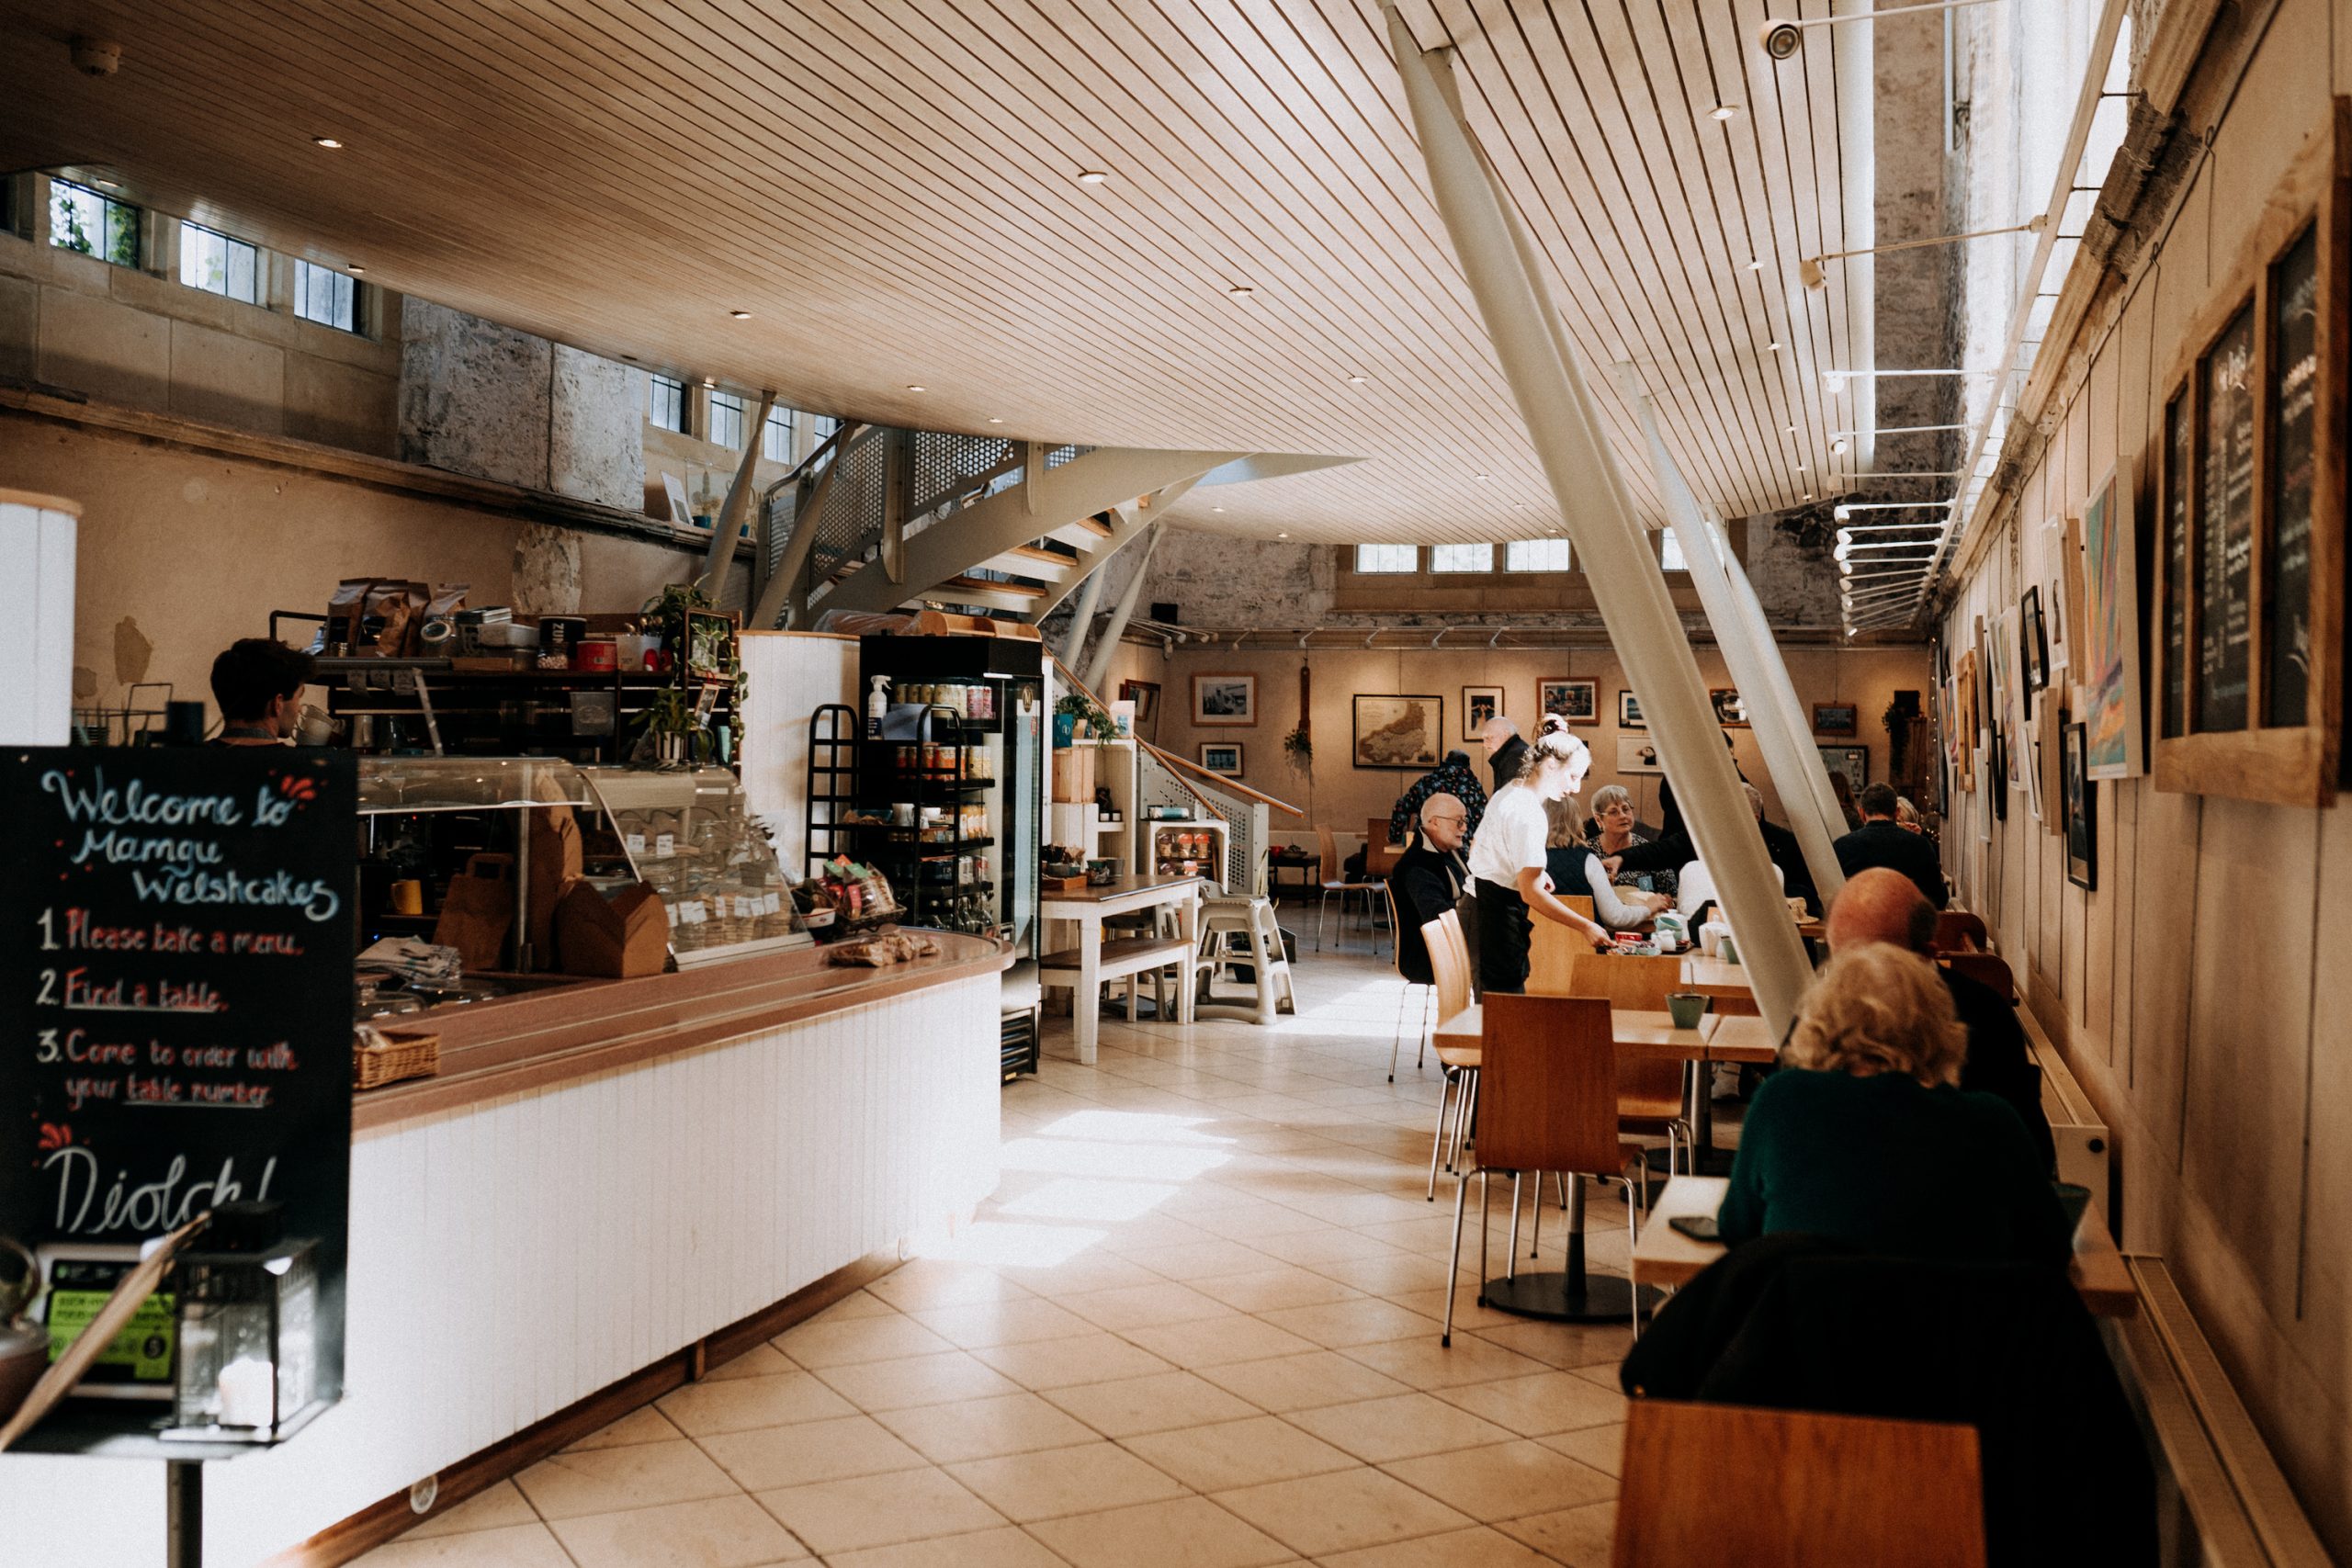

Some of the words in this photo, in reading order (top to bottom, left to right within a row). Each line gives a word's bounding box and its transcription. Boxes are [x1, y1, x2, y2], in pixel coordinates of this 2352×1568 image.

[41, 765, 243, 825] Welcome
[252, 785, 300, 826] to
[71, 829, 224, 876] Mamgu
[132, 870, 339, 921] Welshcakes
[65, 908, 147, 950] Please
[151, 921, 201, 953] take
[209, 931, 227, 953] a
[64, 967, 123, 1008] Find
[132, 983, 149, 1007] a
[65, 1029, 136, 1064] Come
[150, 1040, 175, 1065] to
[182, 1045, 239, 1066] order
[65, 1077, 117, 1111] your
[126, 1073, 182, 1102] table
